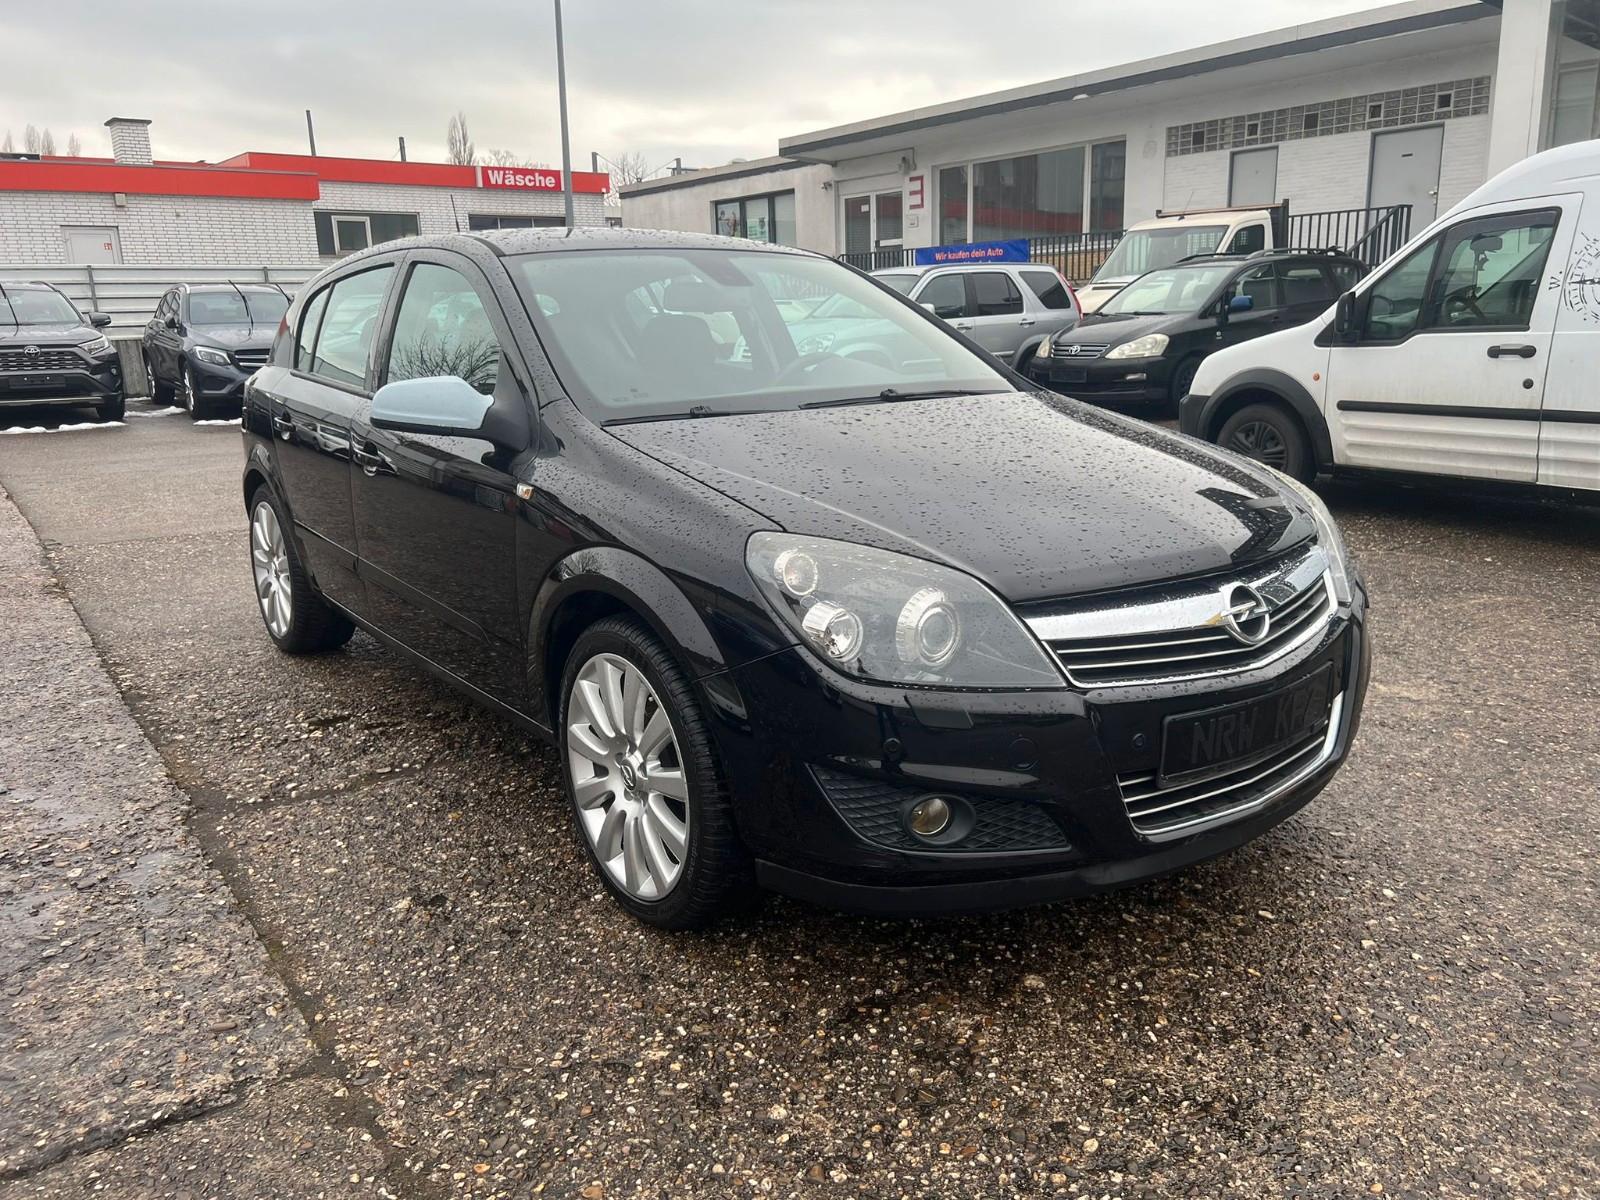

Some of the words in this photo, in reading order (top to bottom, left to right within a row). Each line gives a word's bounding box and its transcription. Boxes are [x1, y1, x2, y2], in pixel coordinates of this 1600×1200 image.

[487, 169, 556, 188] Wäsche
[935, 252, 947, 261] Wir
[948, 250, 970, 260] kaufen
[971, 249, 986, 258] dein
[987, 248, 1004, 257] Auto
[1192, 706, 1260, 764] NRW
